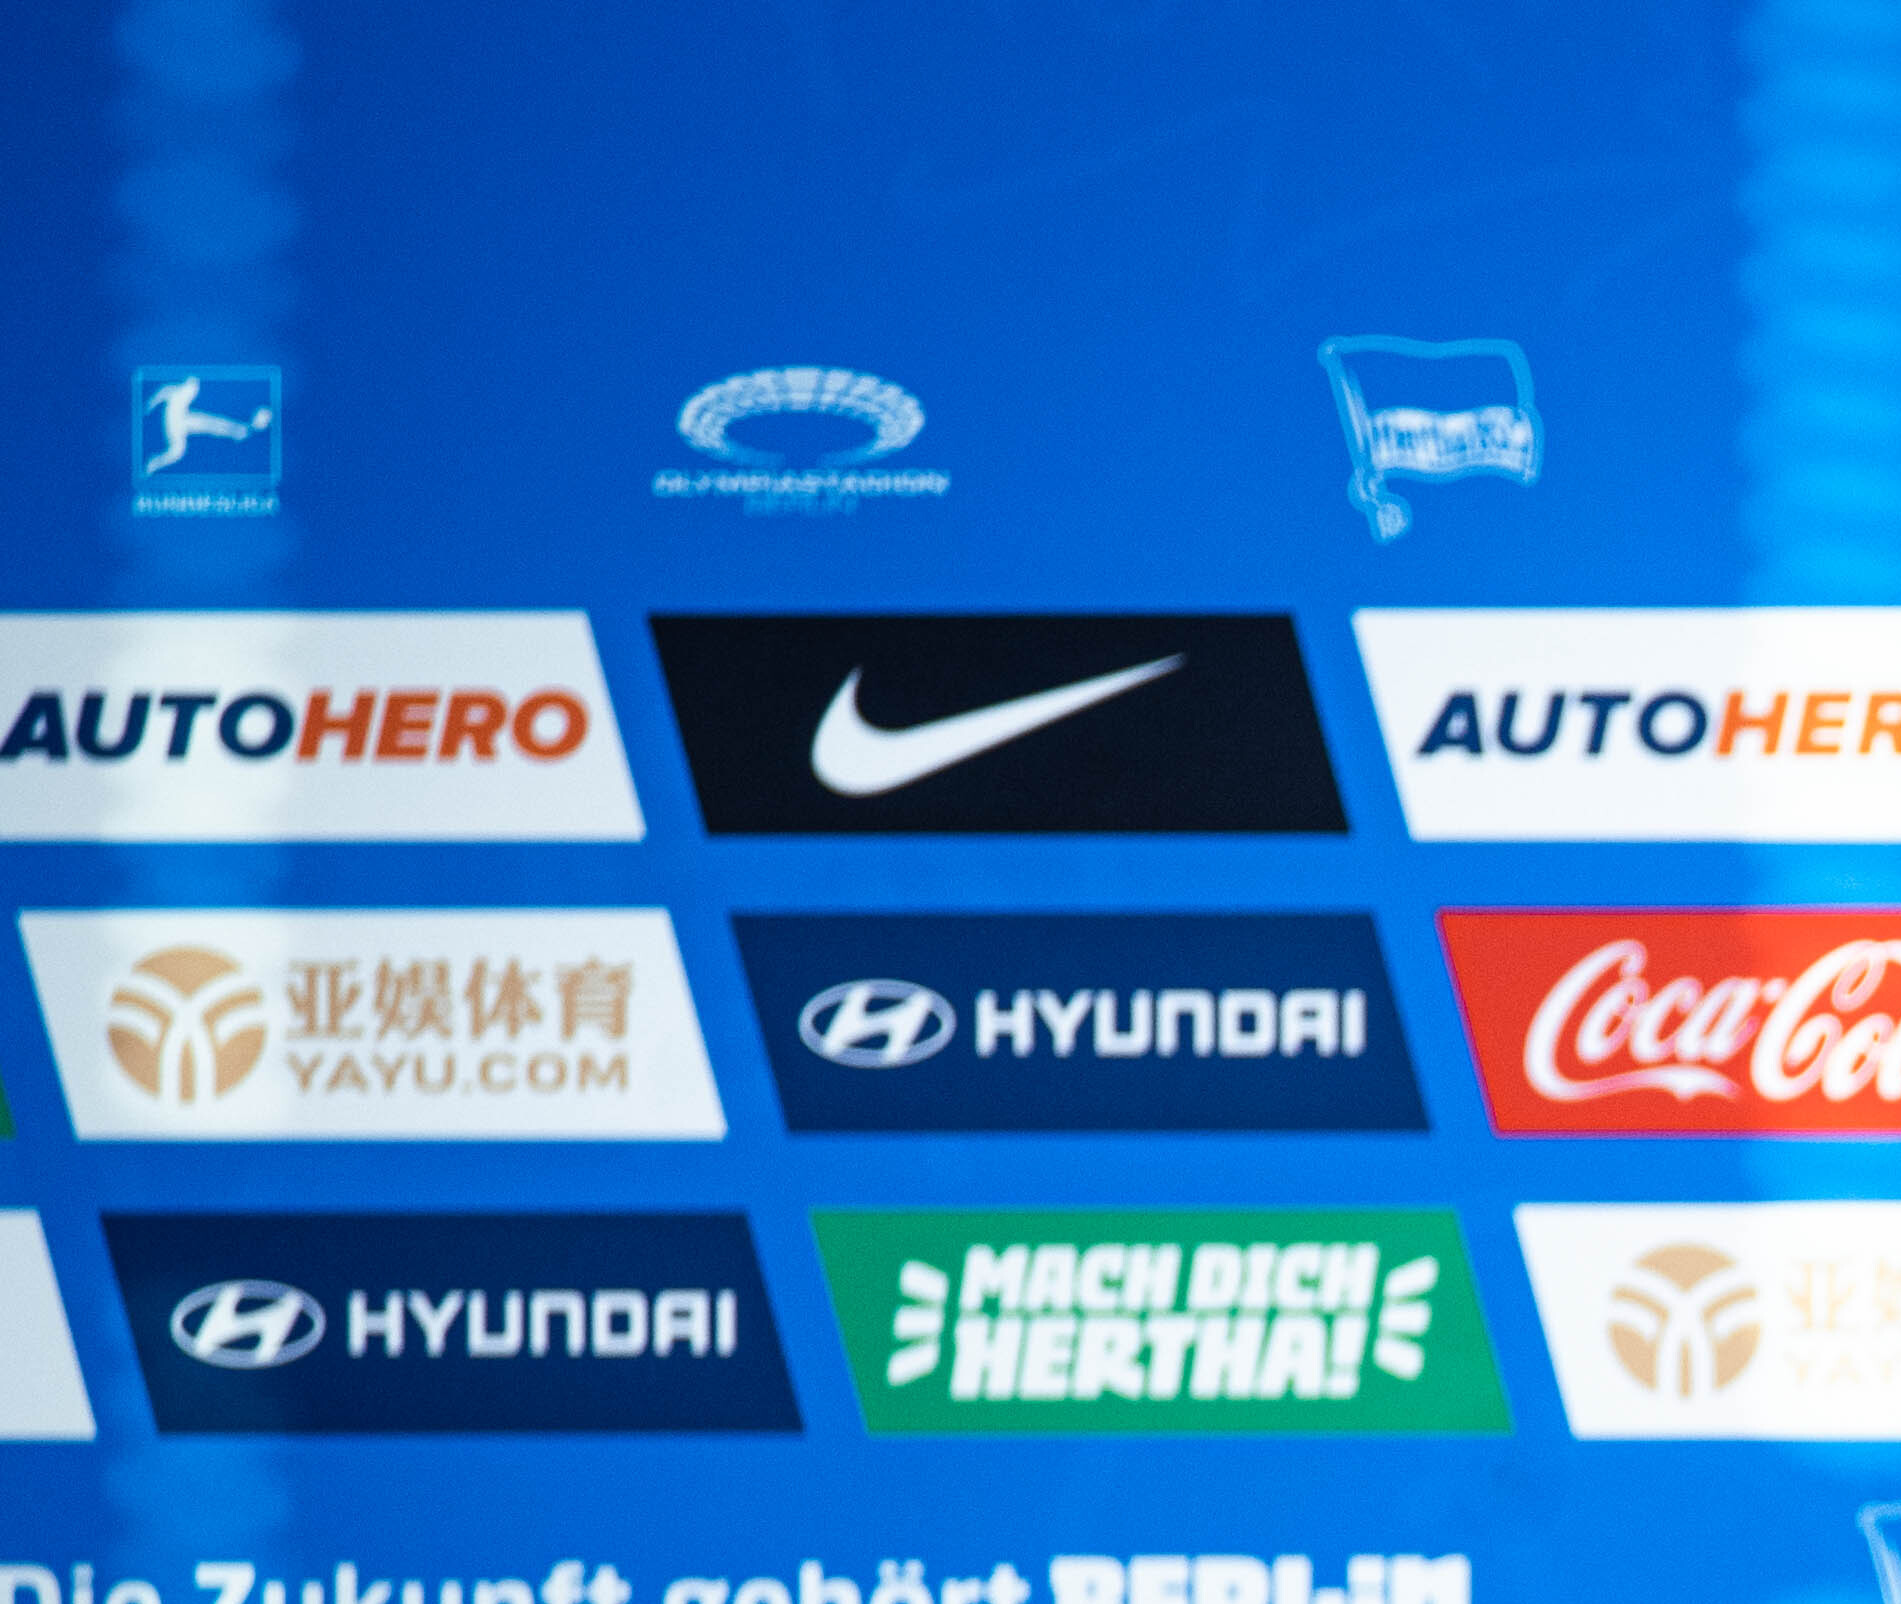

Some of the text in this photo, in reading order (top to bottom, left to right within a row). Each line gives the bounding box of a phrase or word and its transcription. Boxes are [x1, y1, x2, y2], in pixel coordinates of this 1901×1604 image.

[0, 688, 589, 764] AUTOHERO
[974, 990, 1366, 1056] HYUNDAI
[286, 1051, 630, 1096] YAYU.COM
[961, 1243, 1379, 1310] MACH DICH
[347, 1290, 736, 1357] HYUNDAI
[950, 1315, 1366, 1402] HERTHA!
